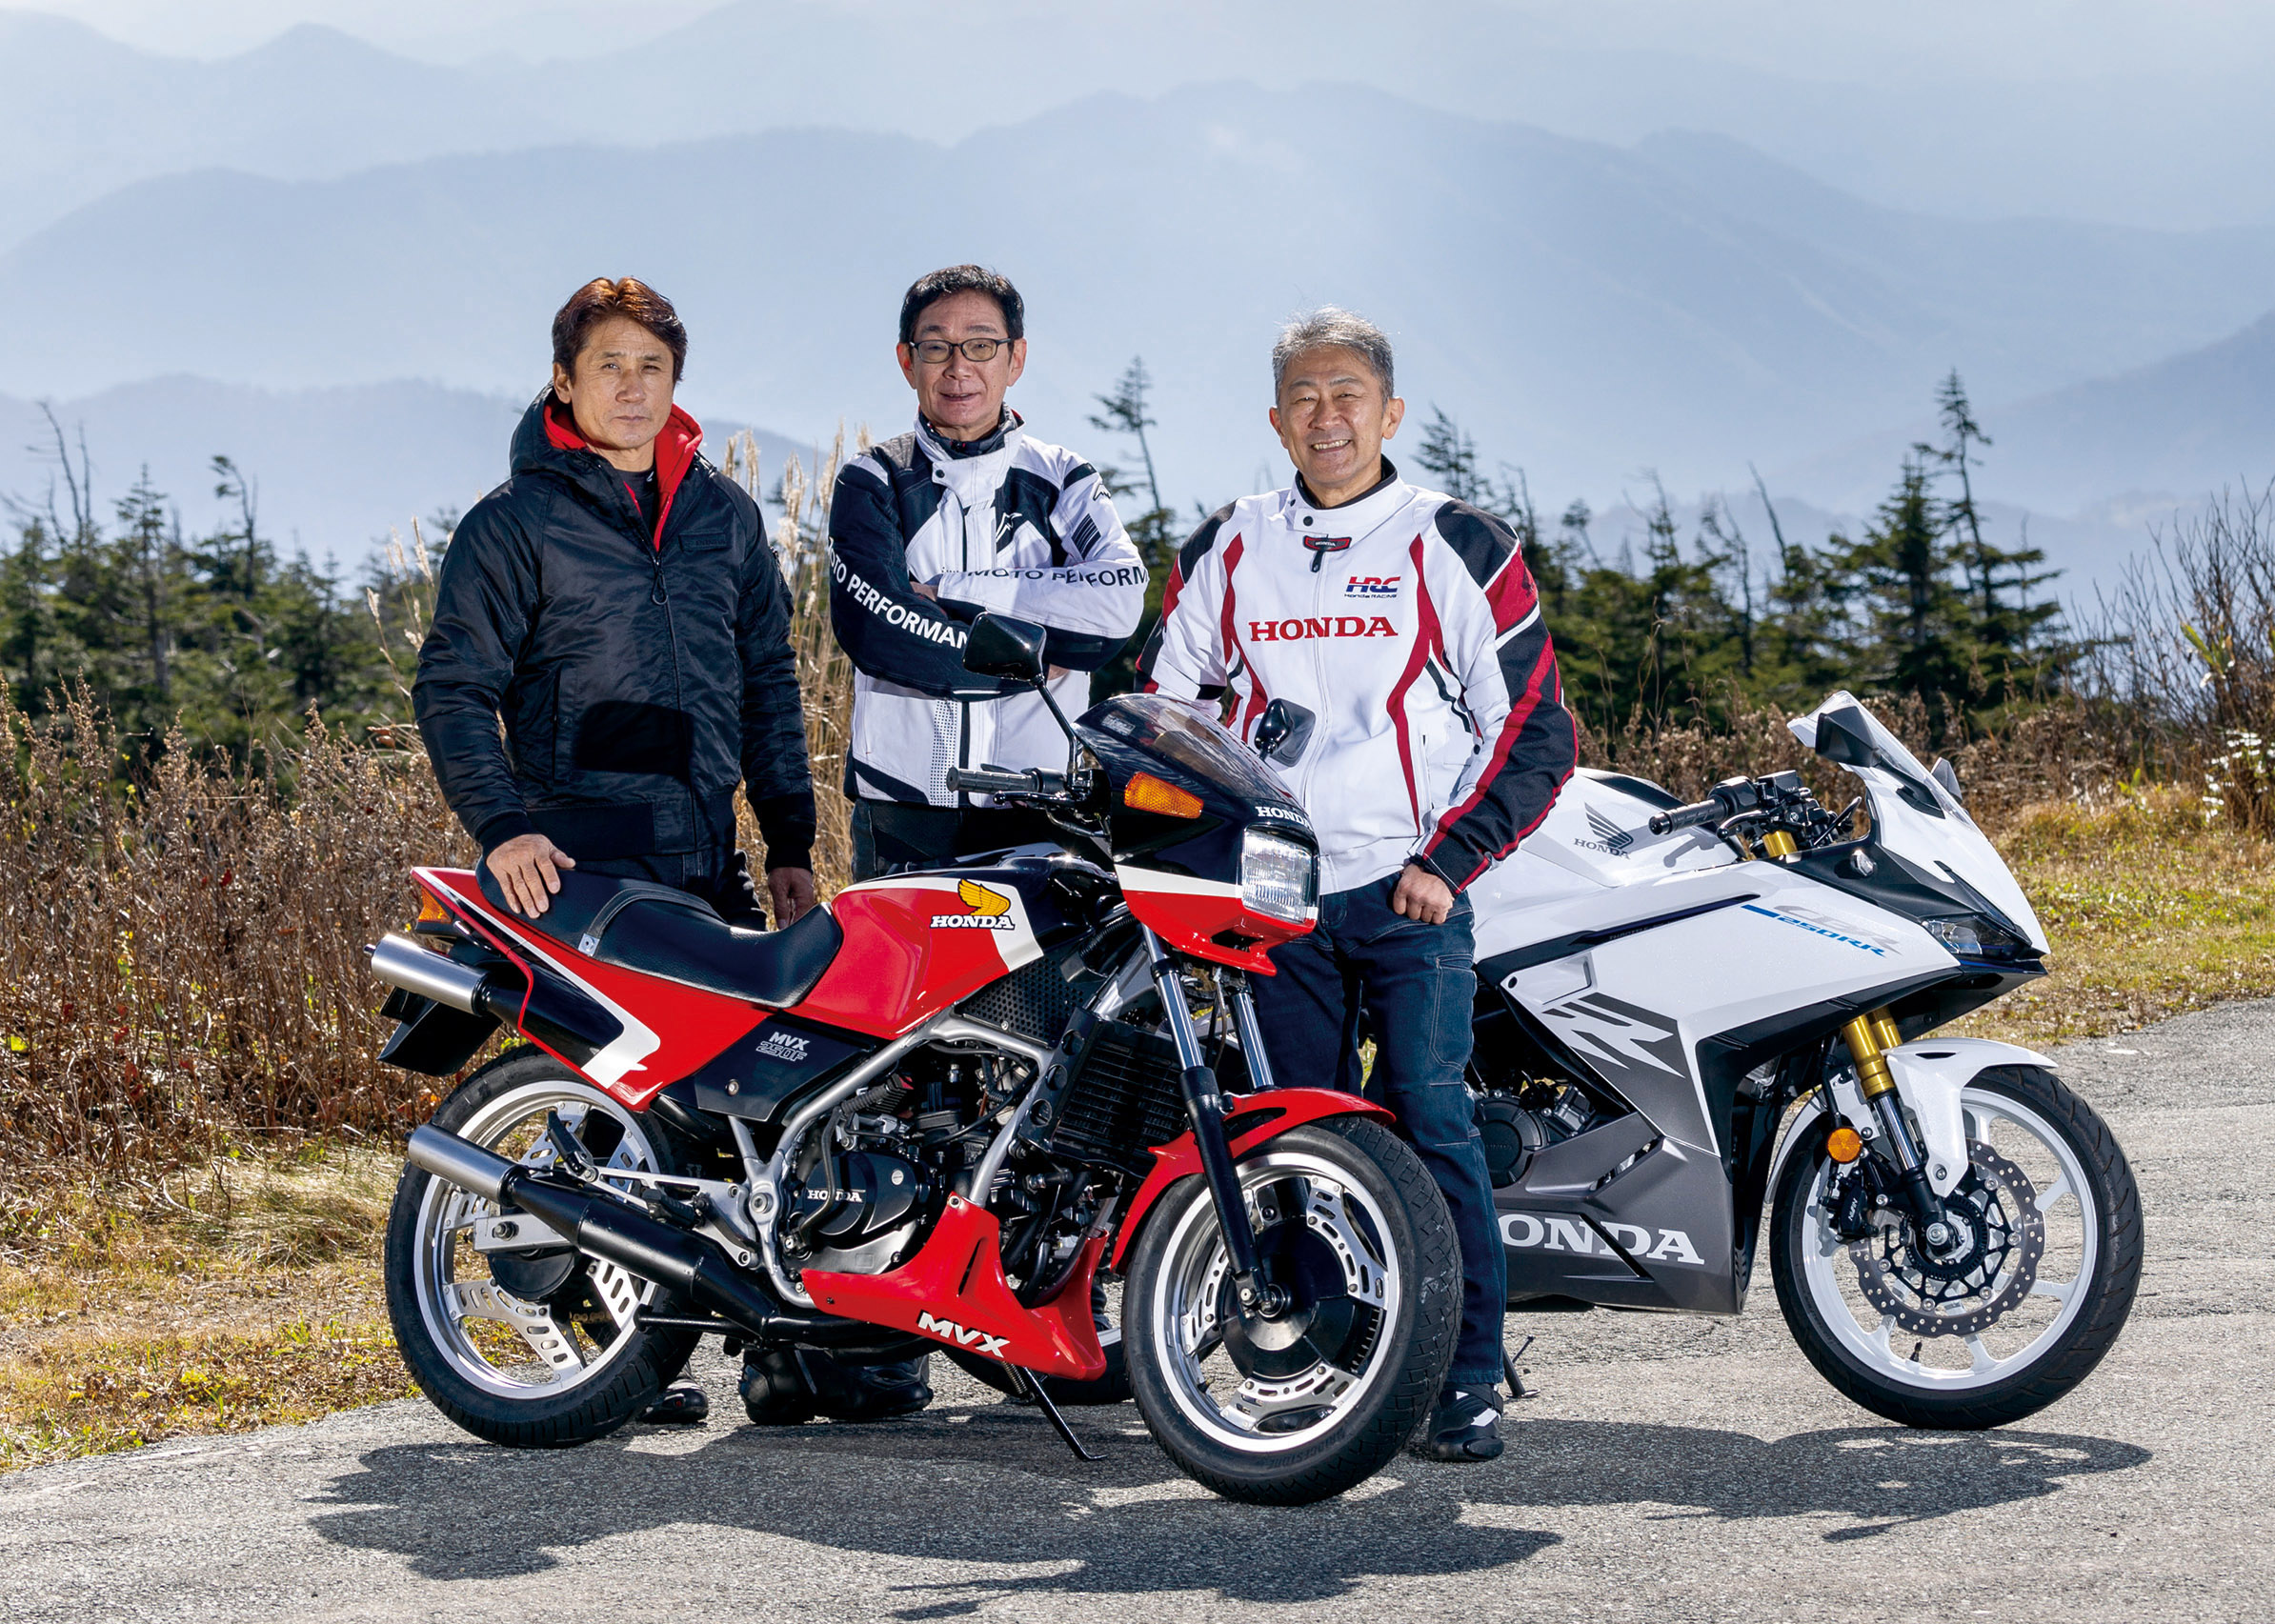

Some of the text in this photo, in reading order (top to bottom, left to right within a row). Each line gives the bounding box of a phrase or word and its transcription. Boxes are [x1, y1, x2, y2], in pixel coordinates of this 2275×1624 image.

[1345, 576, 1401, 593] HRC
[1248, 616, 1399, 642] HONDA
[1574, 837, 1630, 860] HONDA
[930, 914, 1015, 930] HONDA
[1777, 915, 1887, 958] 250RR
[755, 1040, 808, 1062] 250F
[769, 1031, 810, 1052] MVX
[807, 1190, 863, 1203] HODA
[916, 1310, 1011, 1358] MVX
